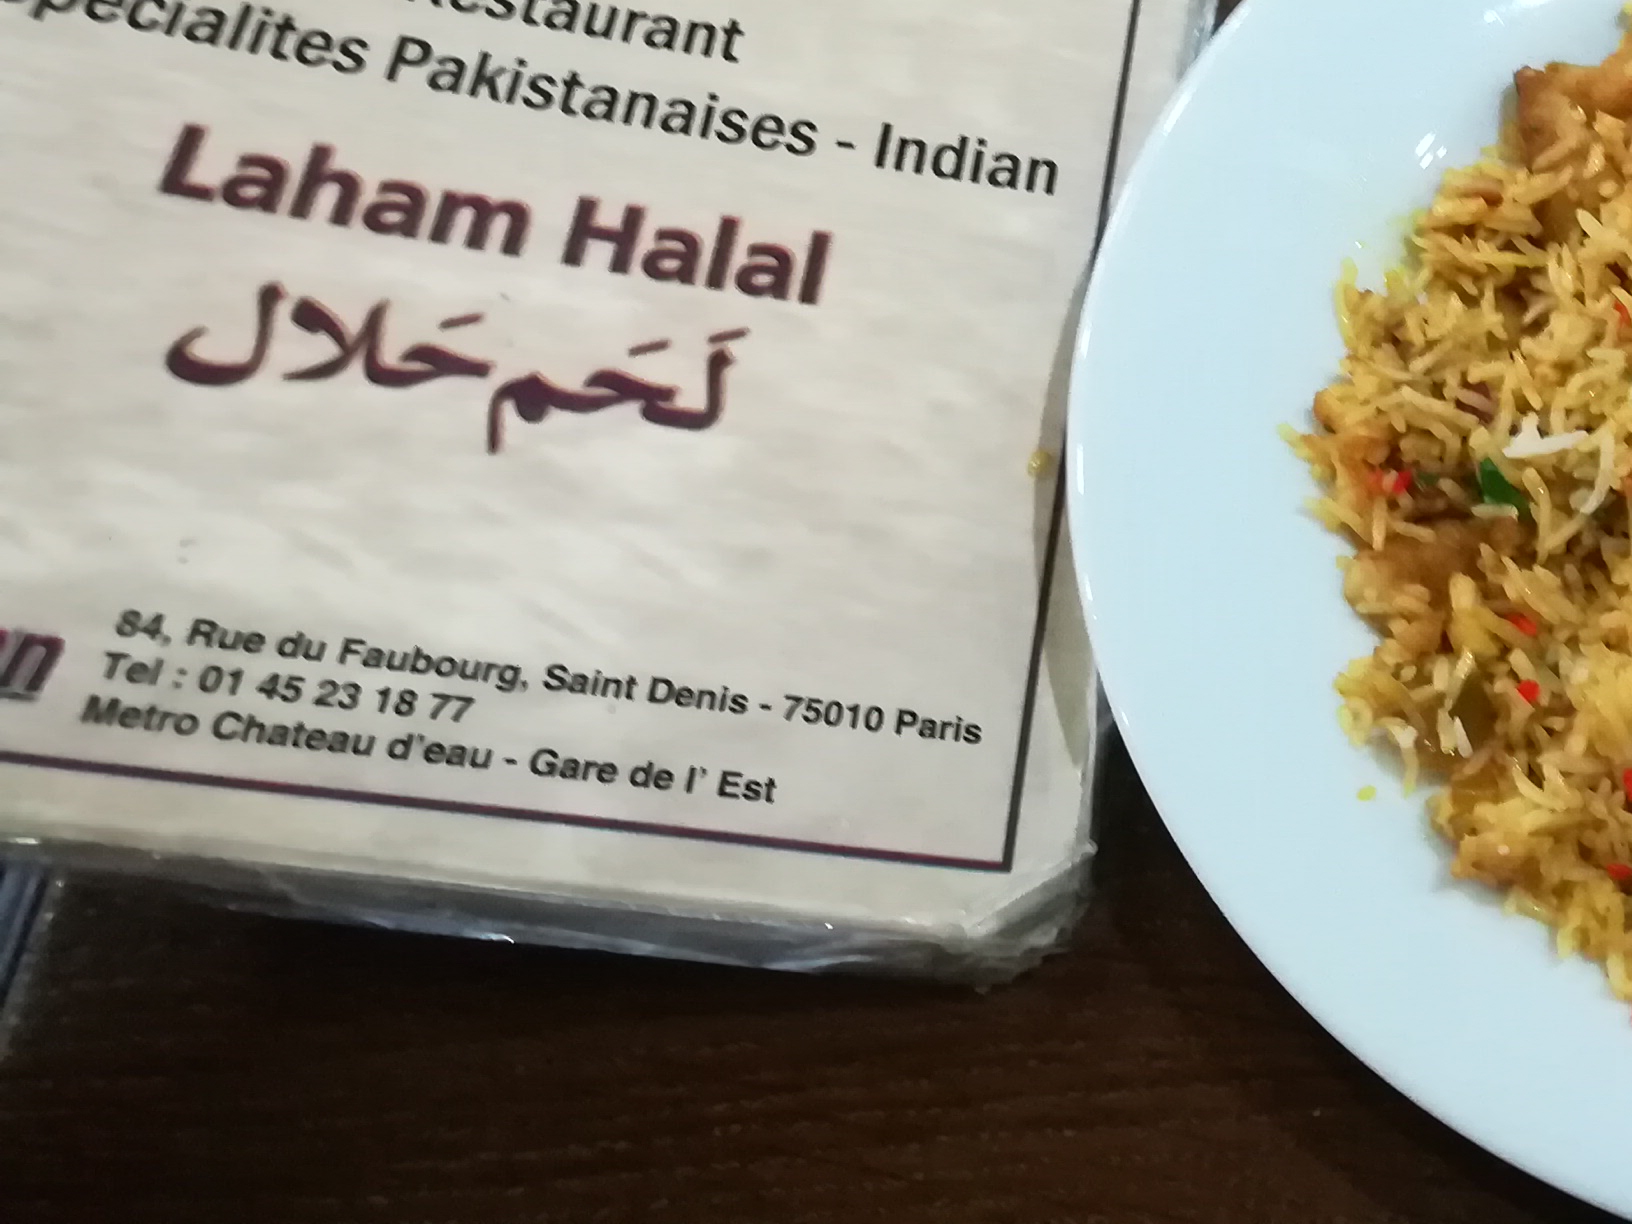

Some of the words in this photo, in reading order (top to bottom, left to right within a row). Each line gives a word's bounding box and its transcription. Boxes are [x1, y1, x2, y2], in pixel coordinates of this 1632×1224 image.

[387, 33, 818, 158] Pakistanaises
[873, 121, 1060, 196] Indian
[157, 123, 532, 256] Laham
[560, 196, 833, 308] Halal
[101, 649, 163, 689] Tel
[197, 663, 244, 697] 01
[256, 671, 303, 706] 45
[313, 677, 360, 713] 23
[373, 683, 417, 719] 18
[427, 690, 475, 725] 77
[115, 608, 171, 645] 84,
[187, 618, 267, 657] Rue
[276, 628, 328, 663] du
[337, 638, 530, 693] Faubourg,
[542, 663, 638, 701] Saint
[646, 677, 750, 716] Denis
[782, 694, 885, 735] 75010
[894, 709, 983, 746] Paris
[80, 694, 200, 738] Metro
[210, 710, 376, 759] Chateau
[387, 731, 492, 772] d'eau
[529, 749, 618, 786] Gare
[628, 759, 677, 791] de
[716, 772, 777, 805] Est
